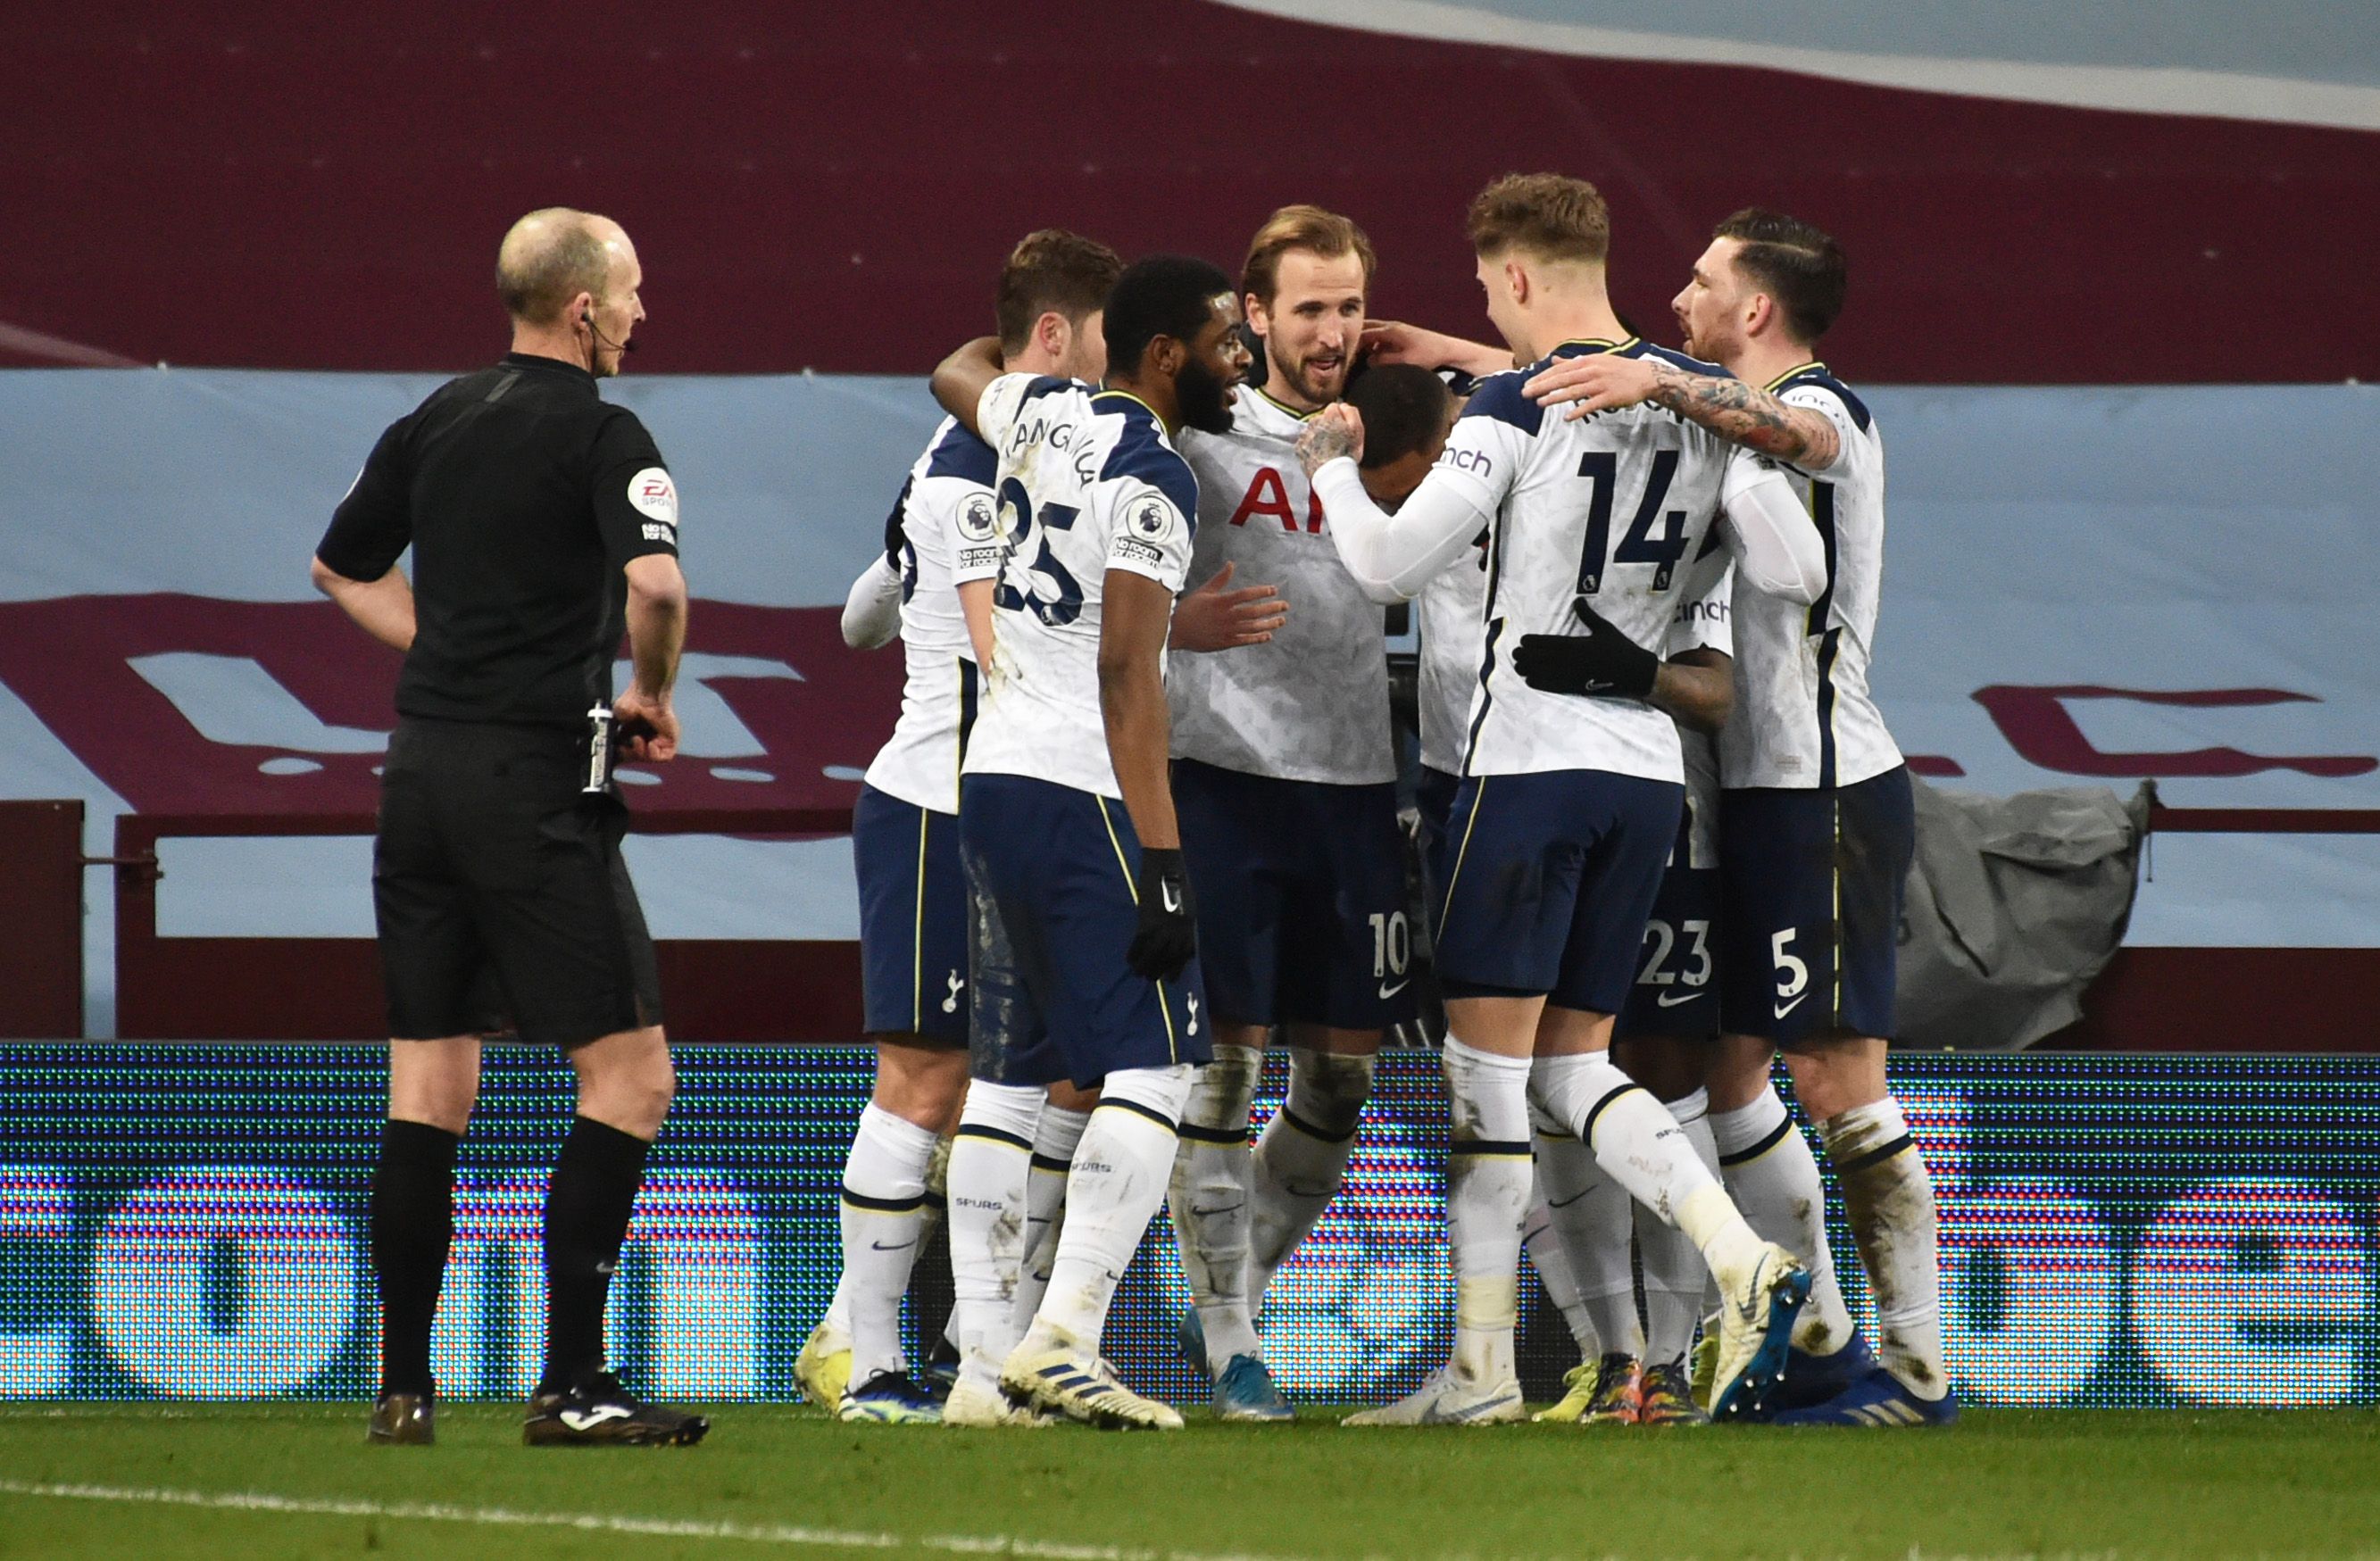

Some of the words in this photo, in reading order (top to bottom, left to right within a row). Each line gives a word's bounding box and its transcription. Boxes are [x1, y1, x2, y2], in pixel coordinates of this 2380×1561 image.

[643, 479, 673, 497] EA
[1441, 447, 1492, 477] nch
[1229, 467, 1323, 534] AI
[1577, 451, 1690, 594] 14
[993, 476, 1085, 627] 25
[1128, 542, 1159, 560] room
[1369, 910, 1409, 977] 10
[1635, 919, 1712, 986] 23
[1772, 927, 1808, 997] 5
[955, 1197, 1003, 1210] SPURS
[0, 1163, 759, 1401] om
